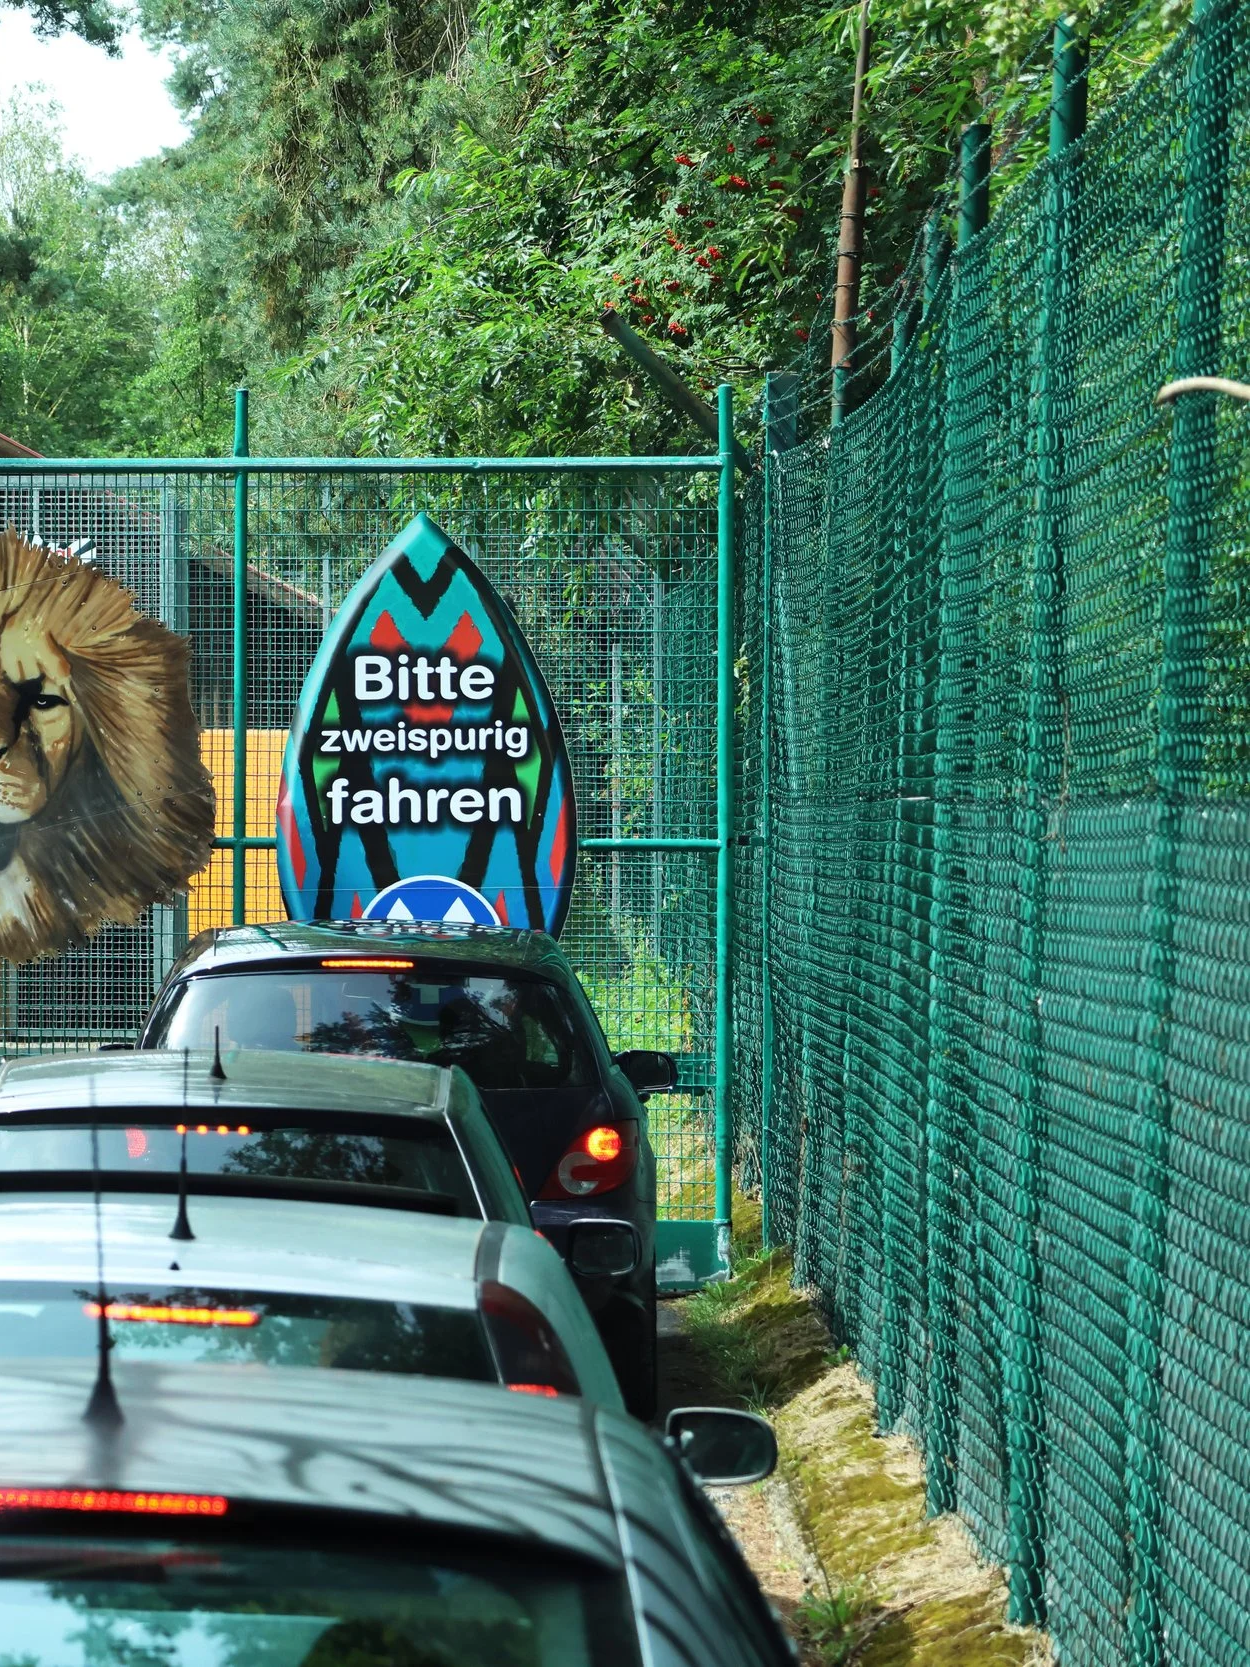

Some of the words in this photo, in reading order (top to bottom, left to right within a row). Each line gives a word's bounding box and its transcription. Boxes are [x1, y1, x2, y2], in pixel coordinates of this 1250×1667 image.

[354, 654, 495, 701] Bitte
[320, 720, 528, 758] zweispurig
[326, 777, 522, 825] fahren
